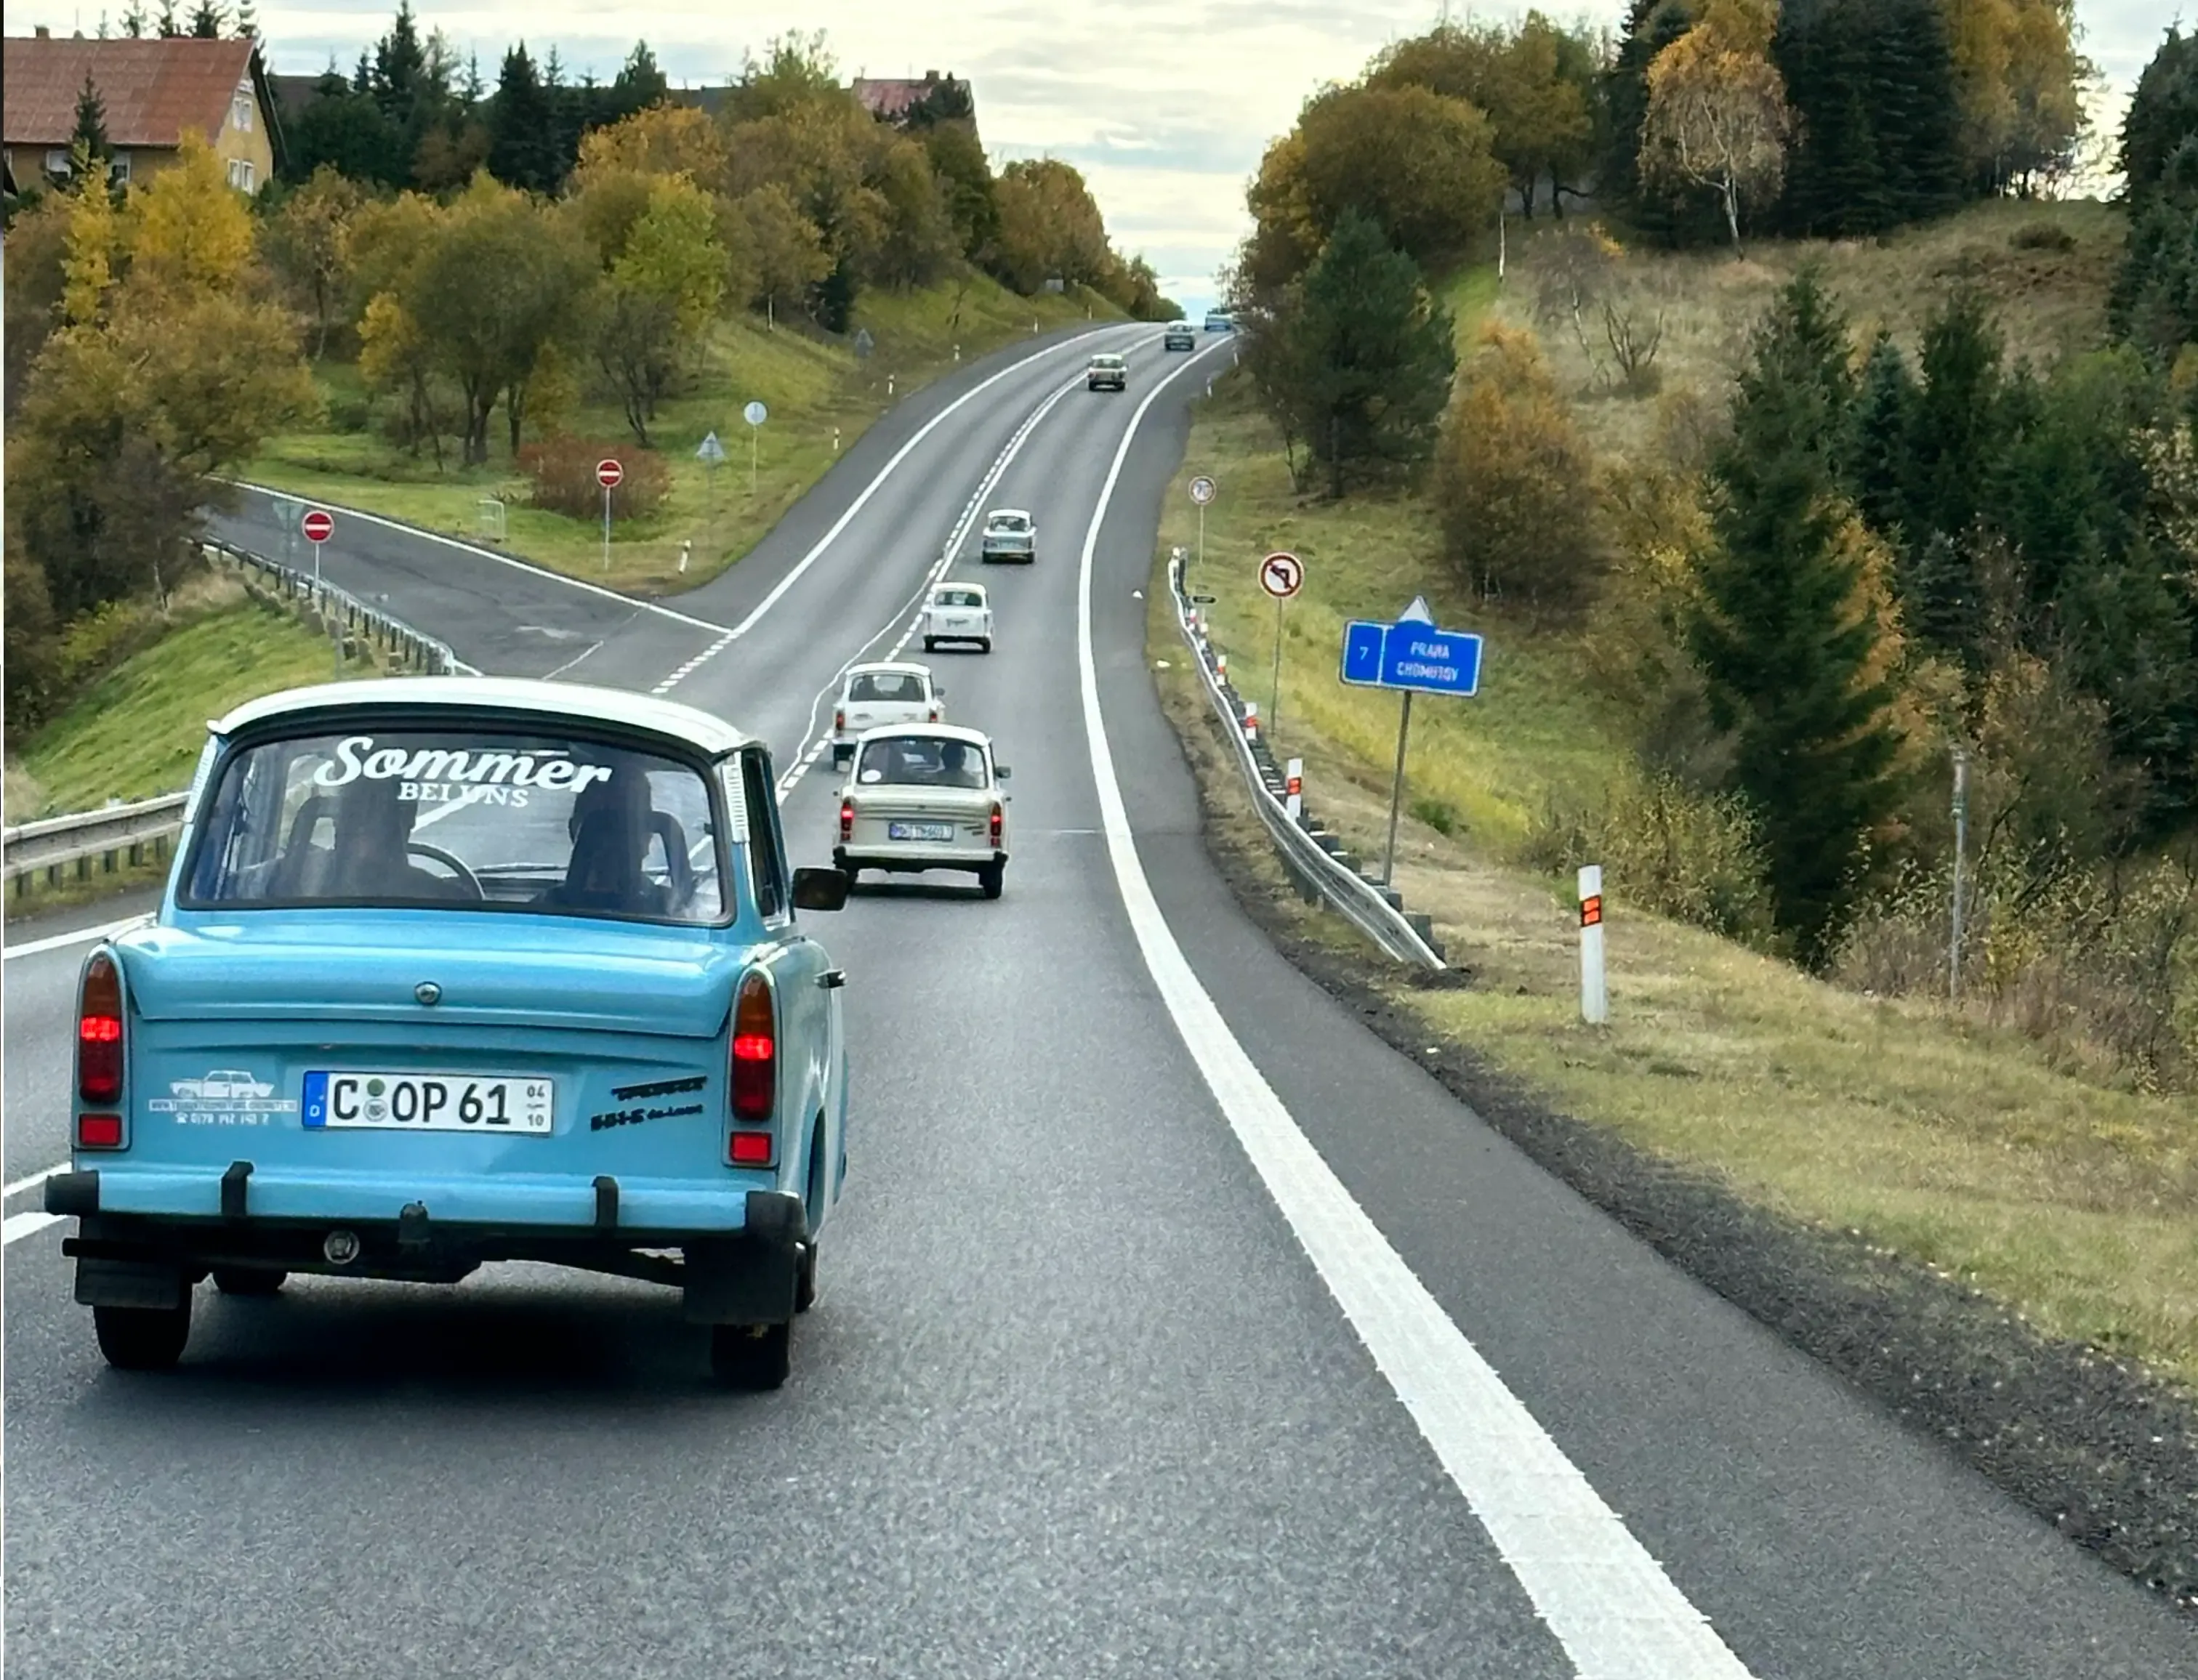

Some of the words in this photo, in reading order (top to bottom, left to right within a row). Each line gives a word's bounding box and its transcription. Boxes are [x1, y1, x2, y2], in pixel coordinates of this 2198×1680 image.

[1359, 646, 1369, 660] 7
[314, 736, 613, 793] Sommer
[398, 782, 450, 801] BEI
[459, 784, 528, 807] UNS
[527, 1085, 545, 1097] 04
[310, 1104, 320, 1117] D
[334, 1079, 359, 1120] C
[392, 1081, 447, 1123] OP
[459, 1083, 511, 1125] 61
[527, 1114, 544, 1126] 10
